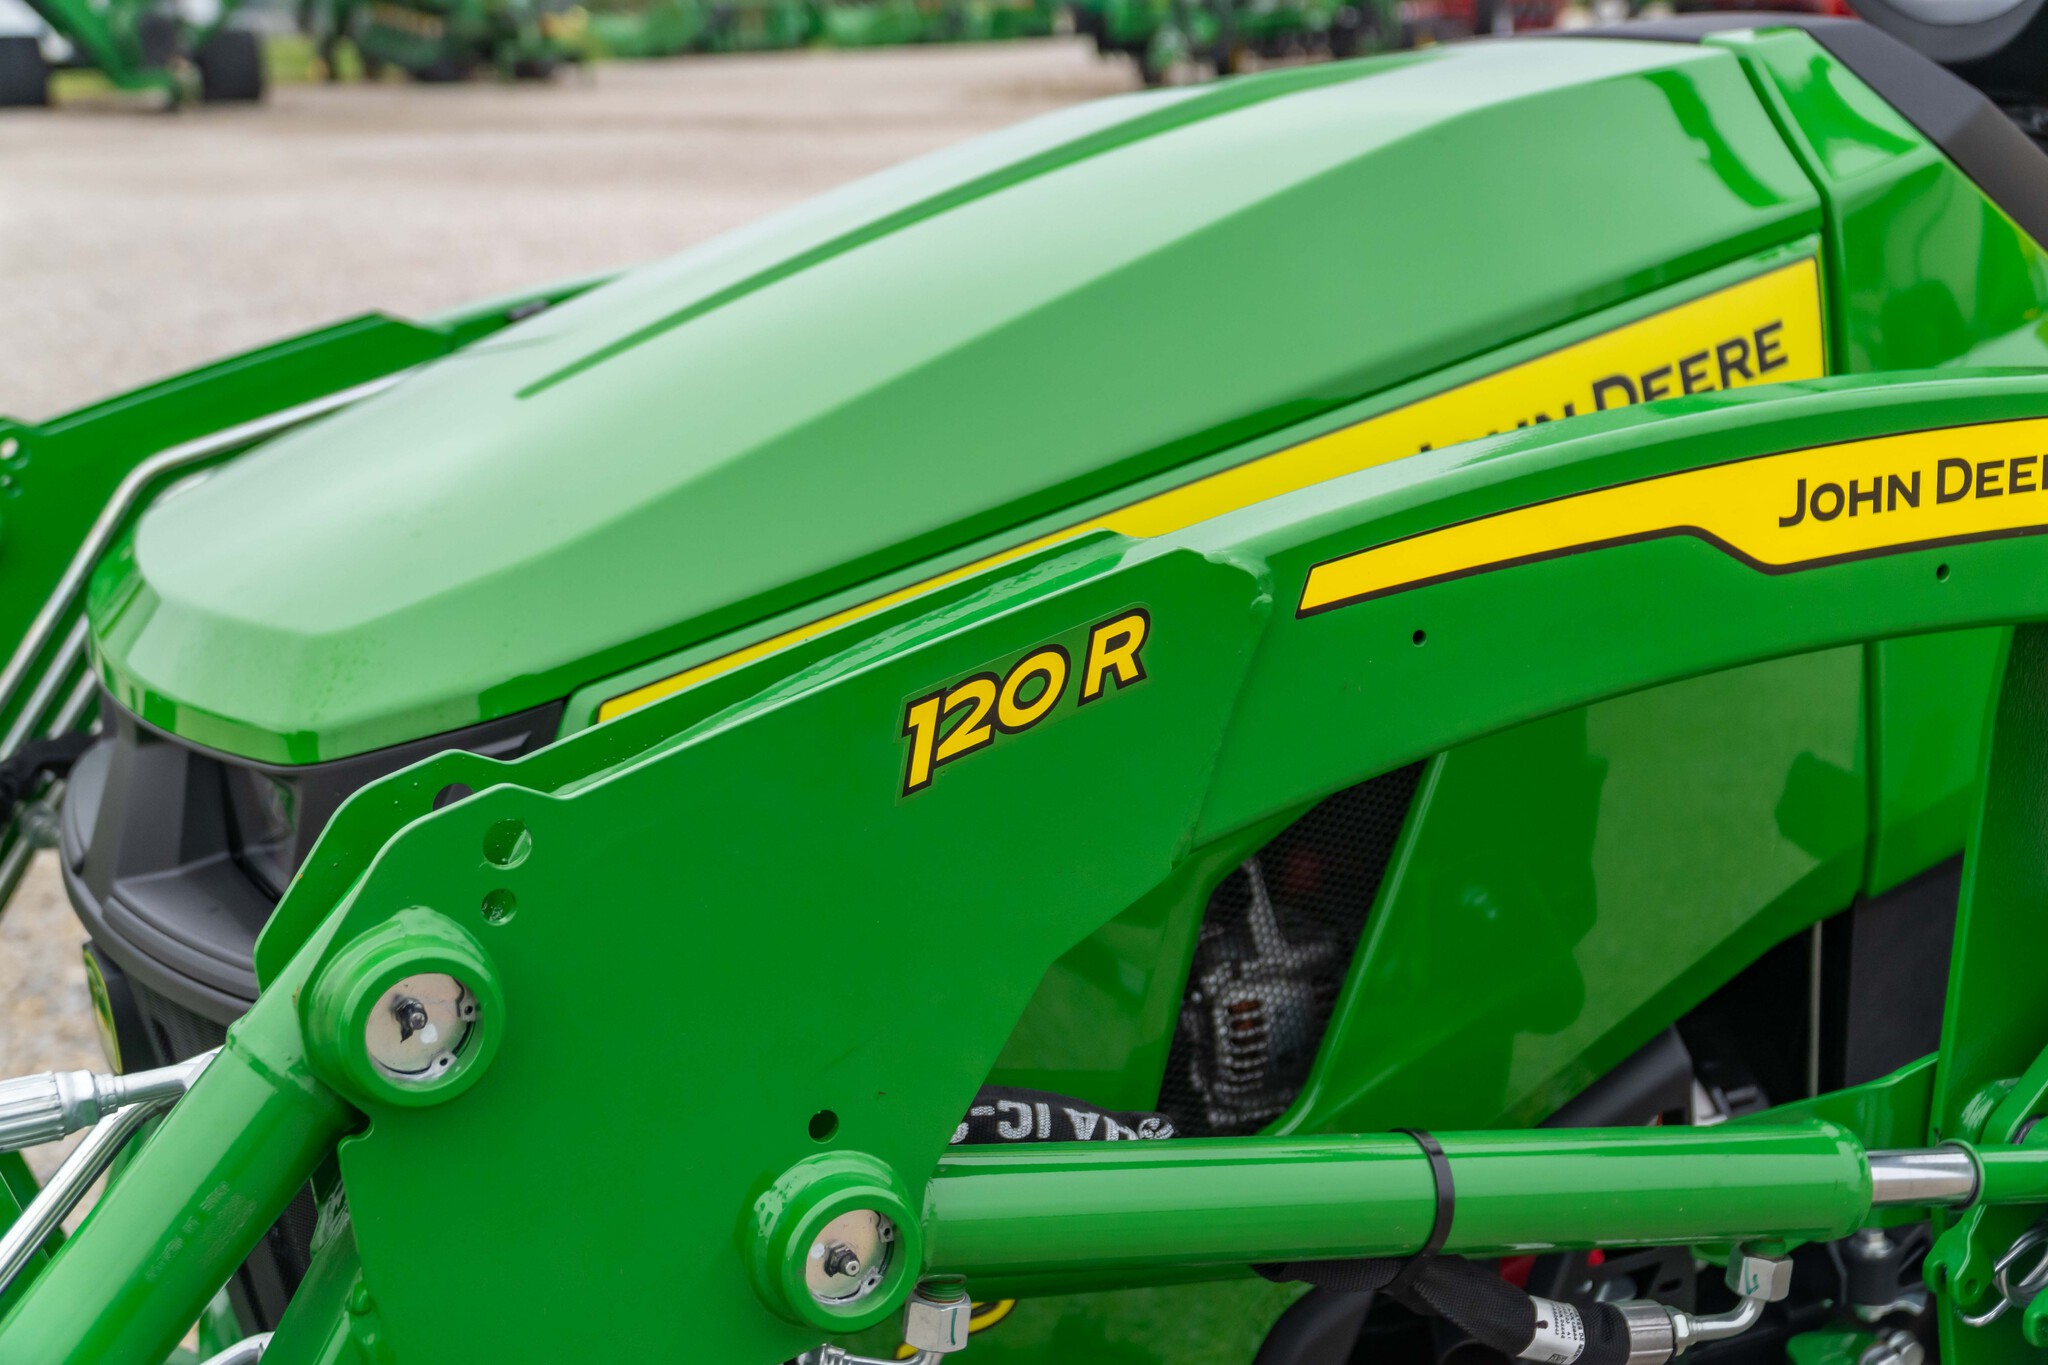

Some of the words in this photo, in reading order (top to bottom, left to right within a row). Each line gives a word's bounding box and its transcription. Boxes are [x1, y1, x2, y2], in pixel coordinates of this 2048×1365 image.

[1778, 470, 1922, 528] JOHN
[1936, 454, 2048, 505] DEE
[901, 644, 1071, 798] 120
[1077, 607, 1151, 708] R
